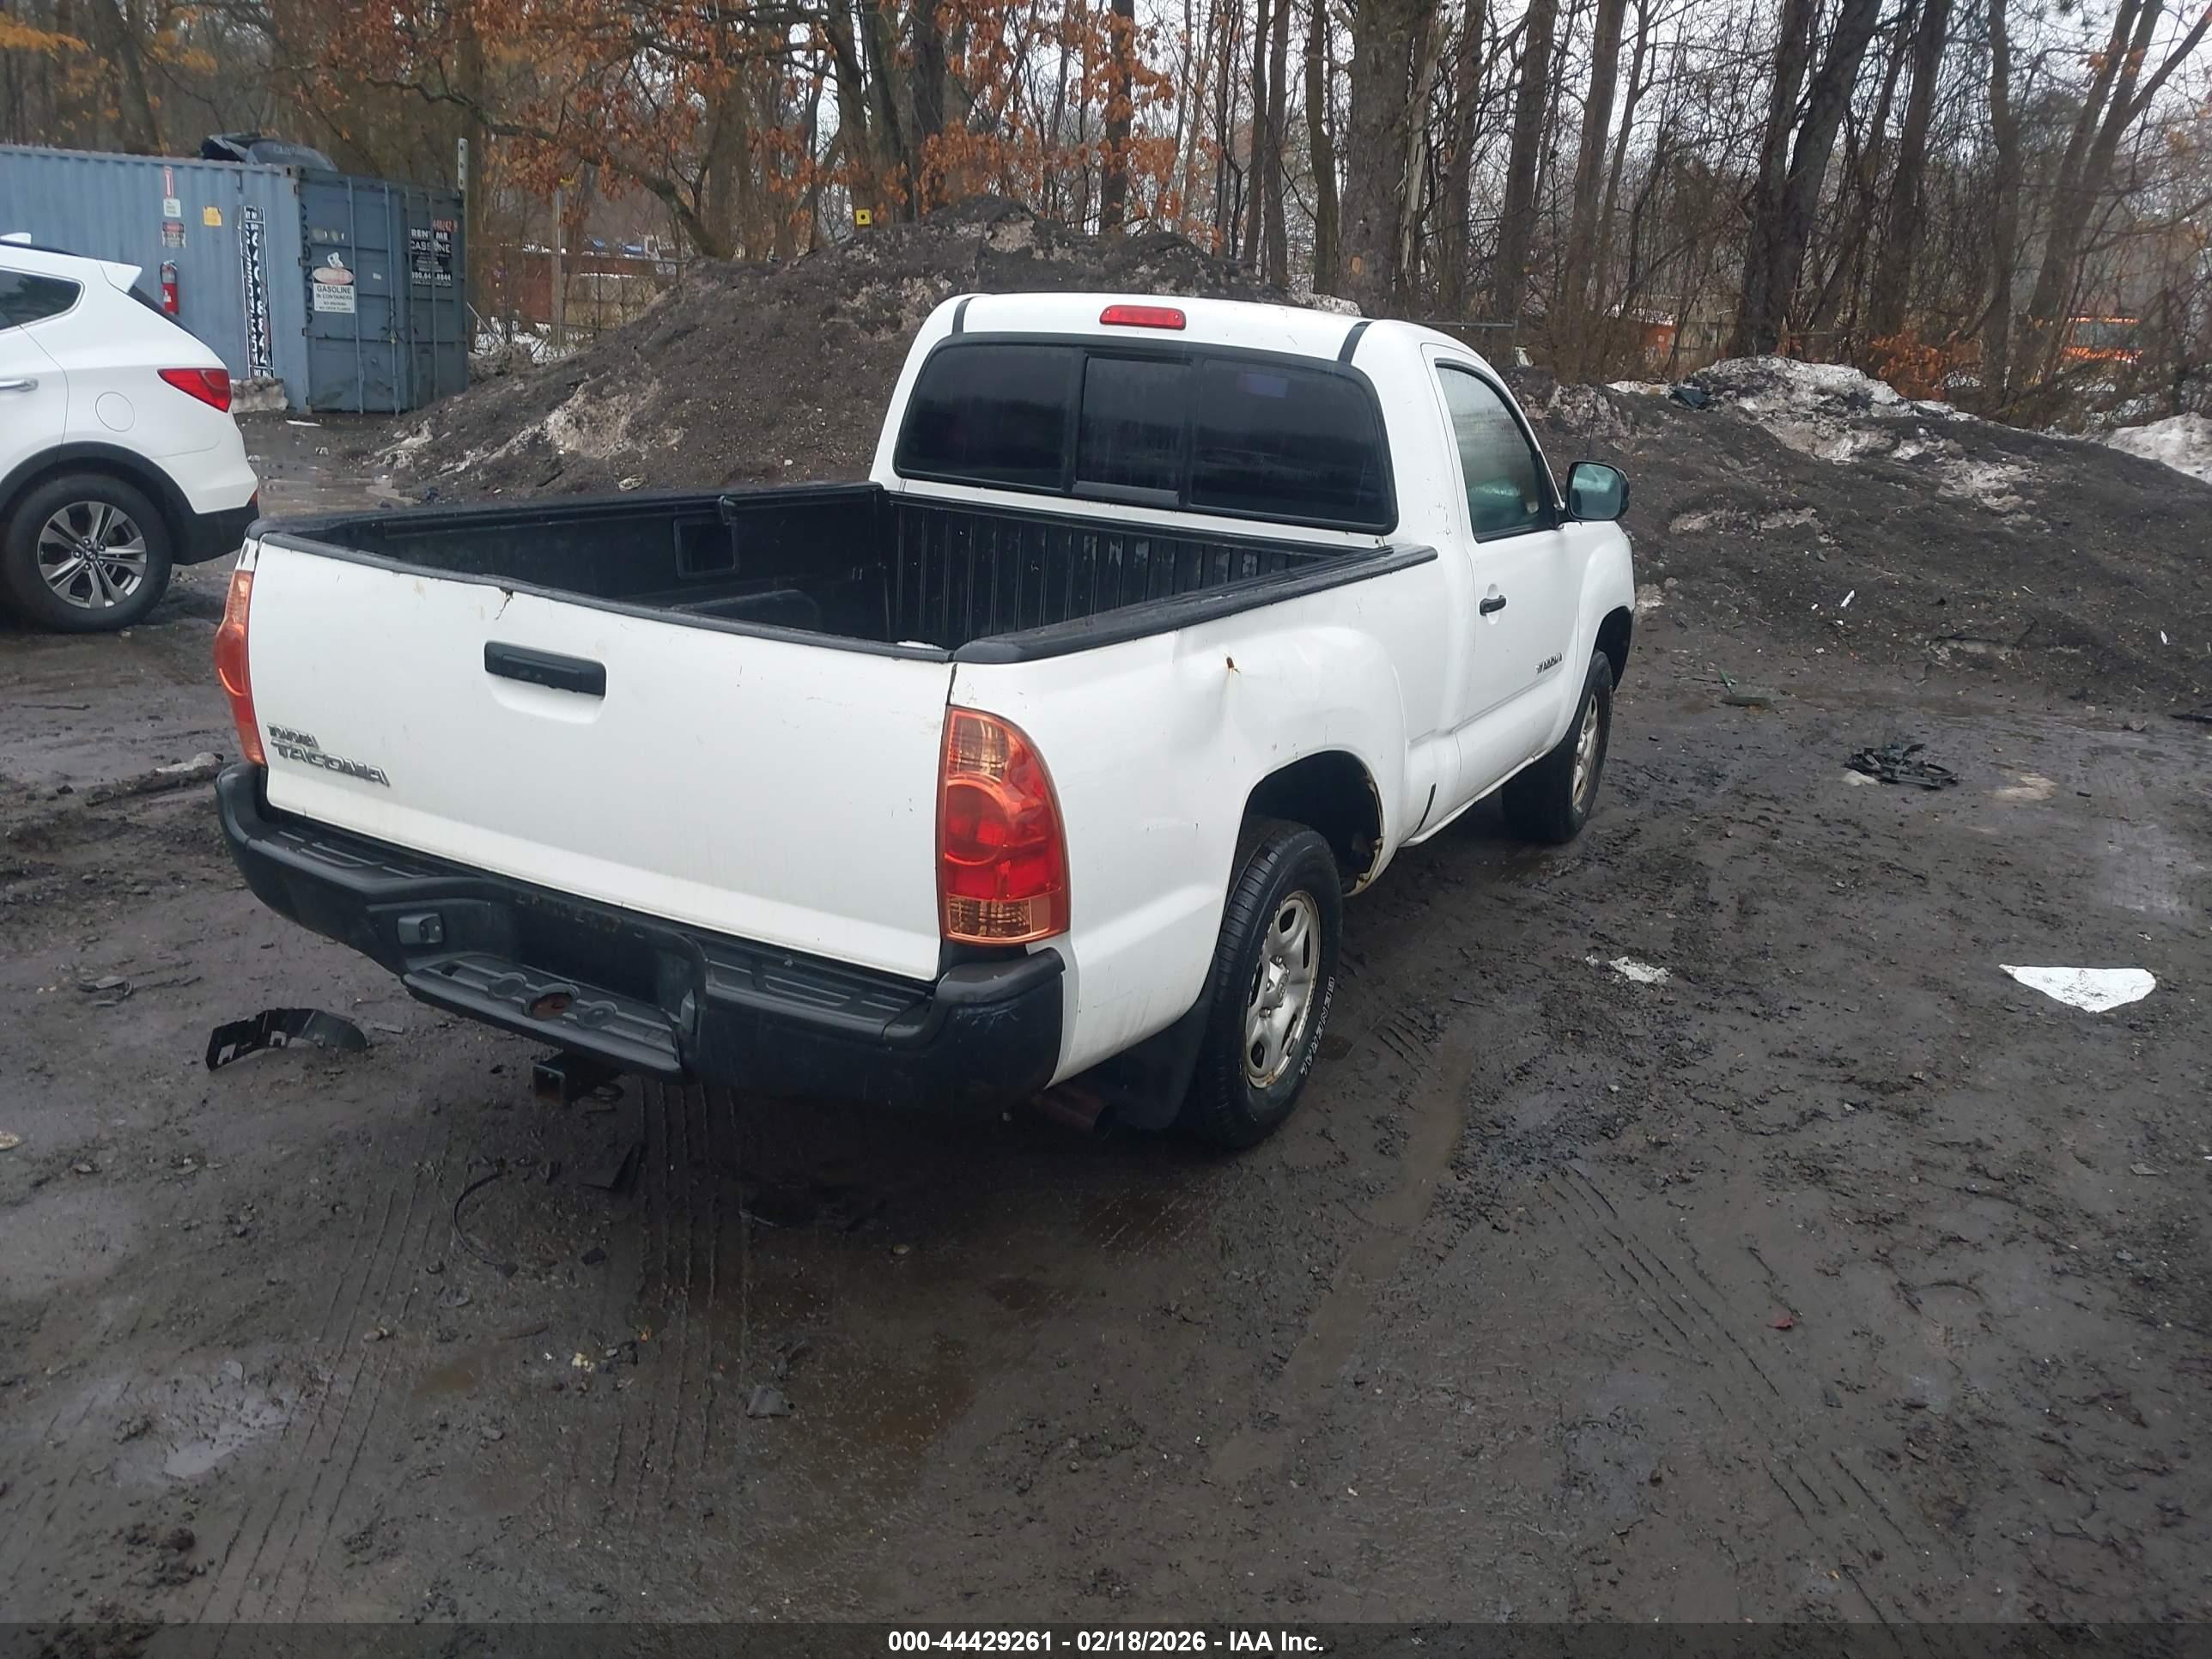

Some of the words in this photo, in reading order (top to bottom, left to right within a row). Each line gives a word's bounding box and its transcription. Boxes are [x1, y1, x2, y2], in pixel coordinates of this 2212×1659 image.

[316, 285, 351, 294] GASOLINE
[270, 738, 391, 788] TACOMA
[1299, 976, 1334, 1075] GENERAL
